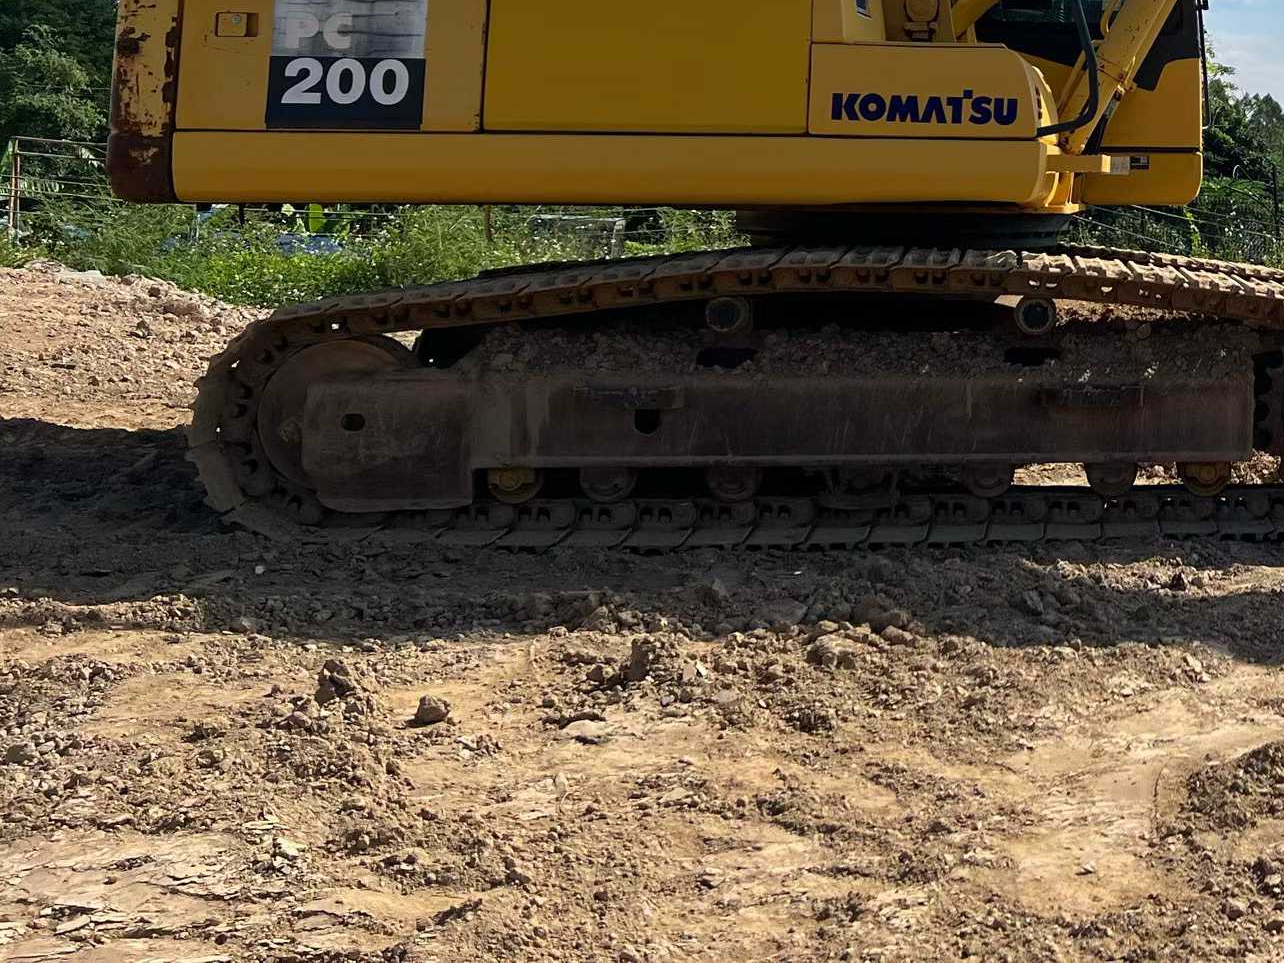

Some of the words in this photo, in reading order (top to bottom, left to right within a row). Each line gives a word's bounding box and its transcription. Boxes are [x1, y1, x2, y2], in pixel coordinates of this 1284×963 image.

[284, 11, 353, 50] PC
[280, 57, 410, 106] 200
[831, 89, 1018, 125] KOMATSU
